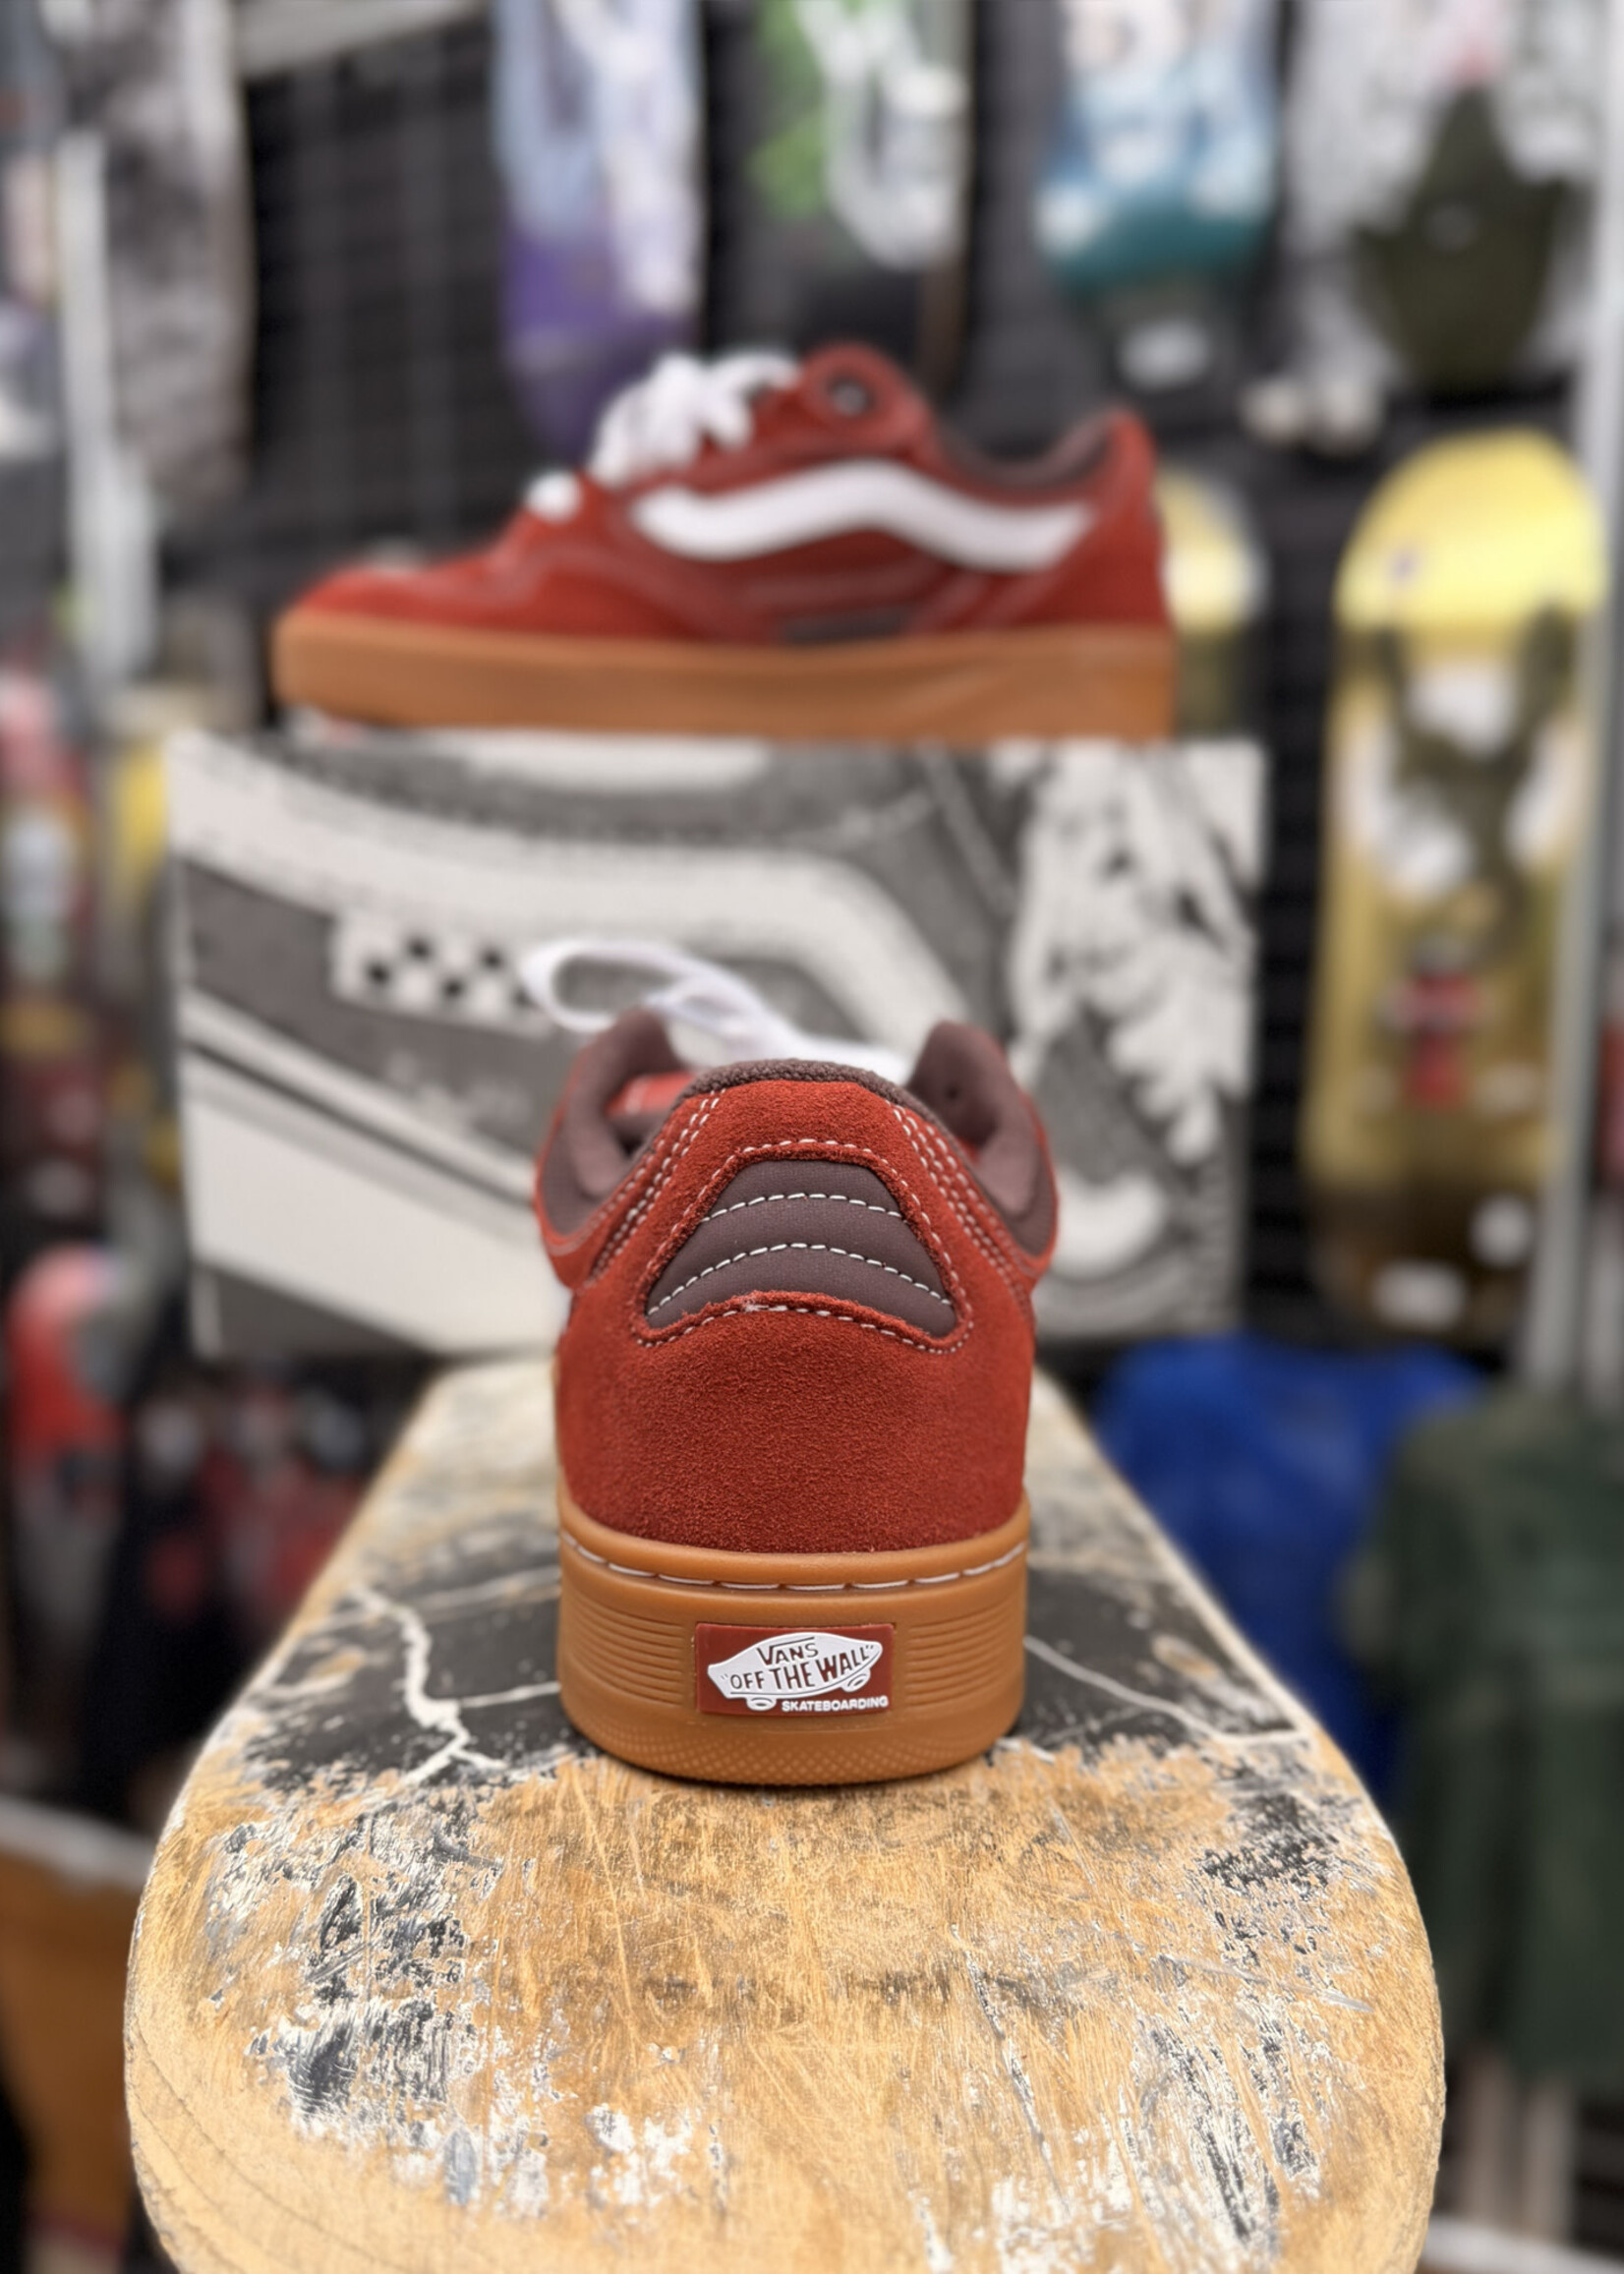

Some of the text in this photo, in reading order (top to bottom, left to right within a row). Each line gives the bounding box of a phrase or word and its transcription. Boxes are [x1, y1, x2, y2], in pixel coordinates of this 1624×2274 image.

[757, 1636, 819, 1665] VANS
[769, 1662, 815, 1690] THE
[782, 1695, 889, 1712] SKATEBOARDING
